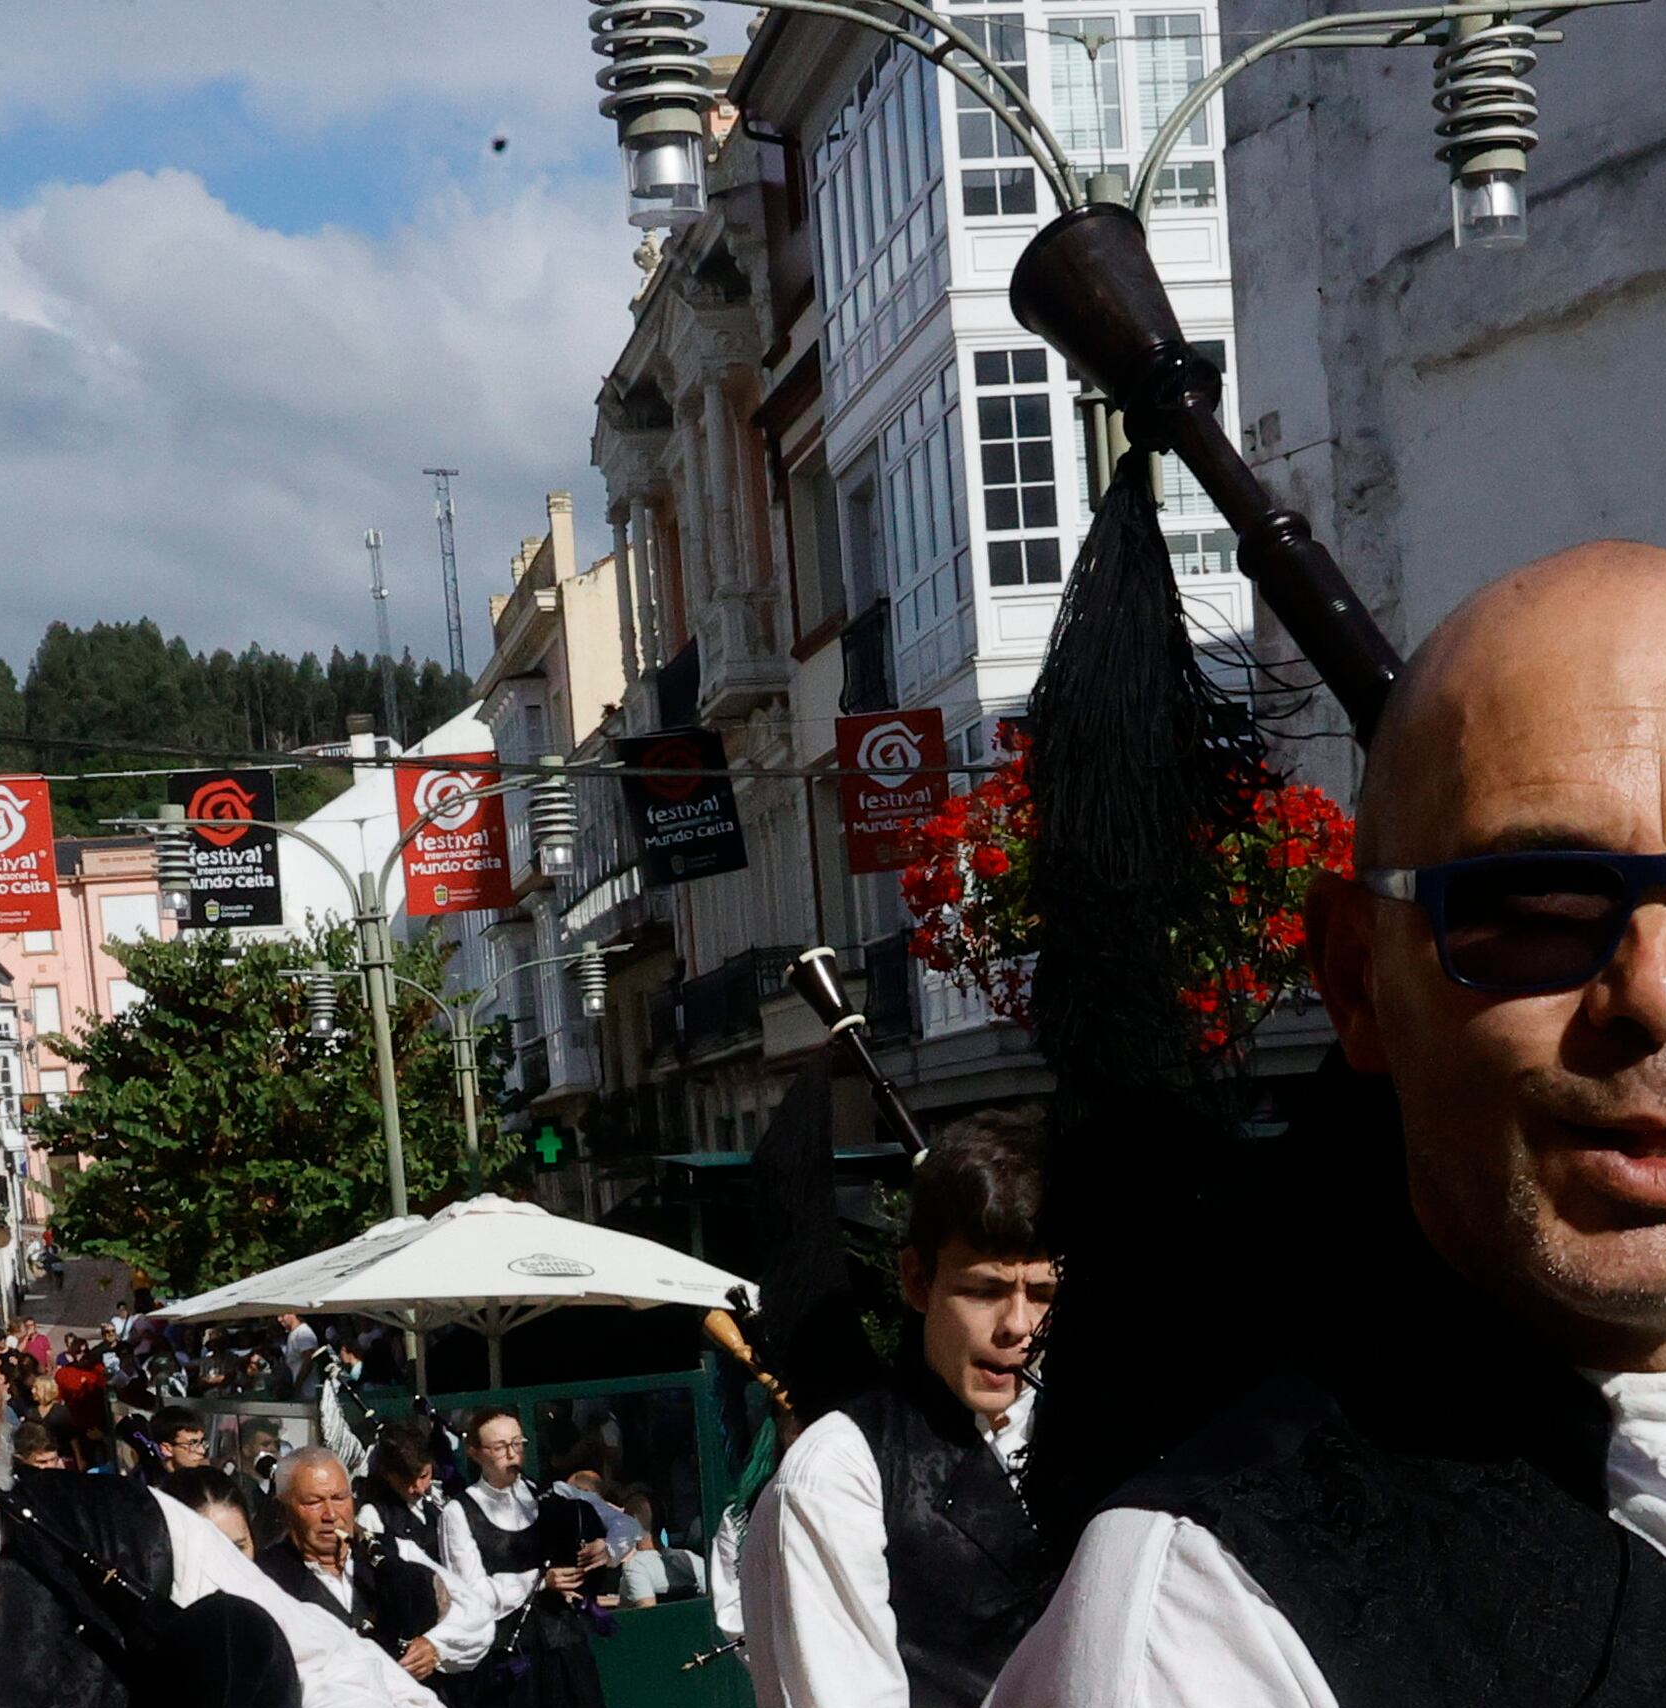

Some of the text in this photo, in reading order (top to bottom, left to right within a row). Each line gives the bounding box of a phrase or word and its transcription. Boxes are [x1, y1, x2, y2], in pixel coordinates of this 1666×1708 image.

[647, 794, 719, 824] festival
[859, 786, 932, 810] festival
[415, 829, 489, 851] festival
[644, 830, 694, 849] Mundo
[696, 821, 734, 837] Celta
[410, 856, 501, 877] Mundo Celta
[11, 880, 51, 894] Celta
[235, 874, 274, 887] Celta
